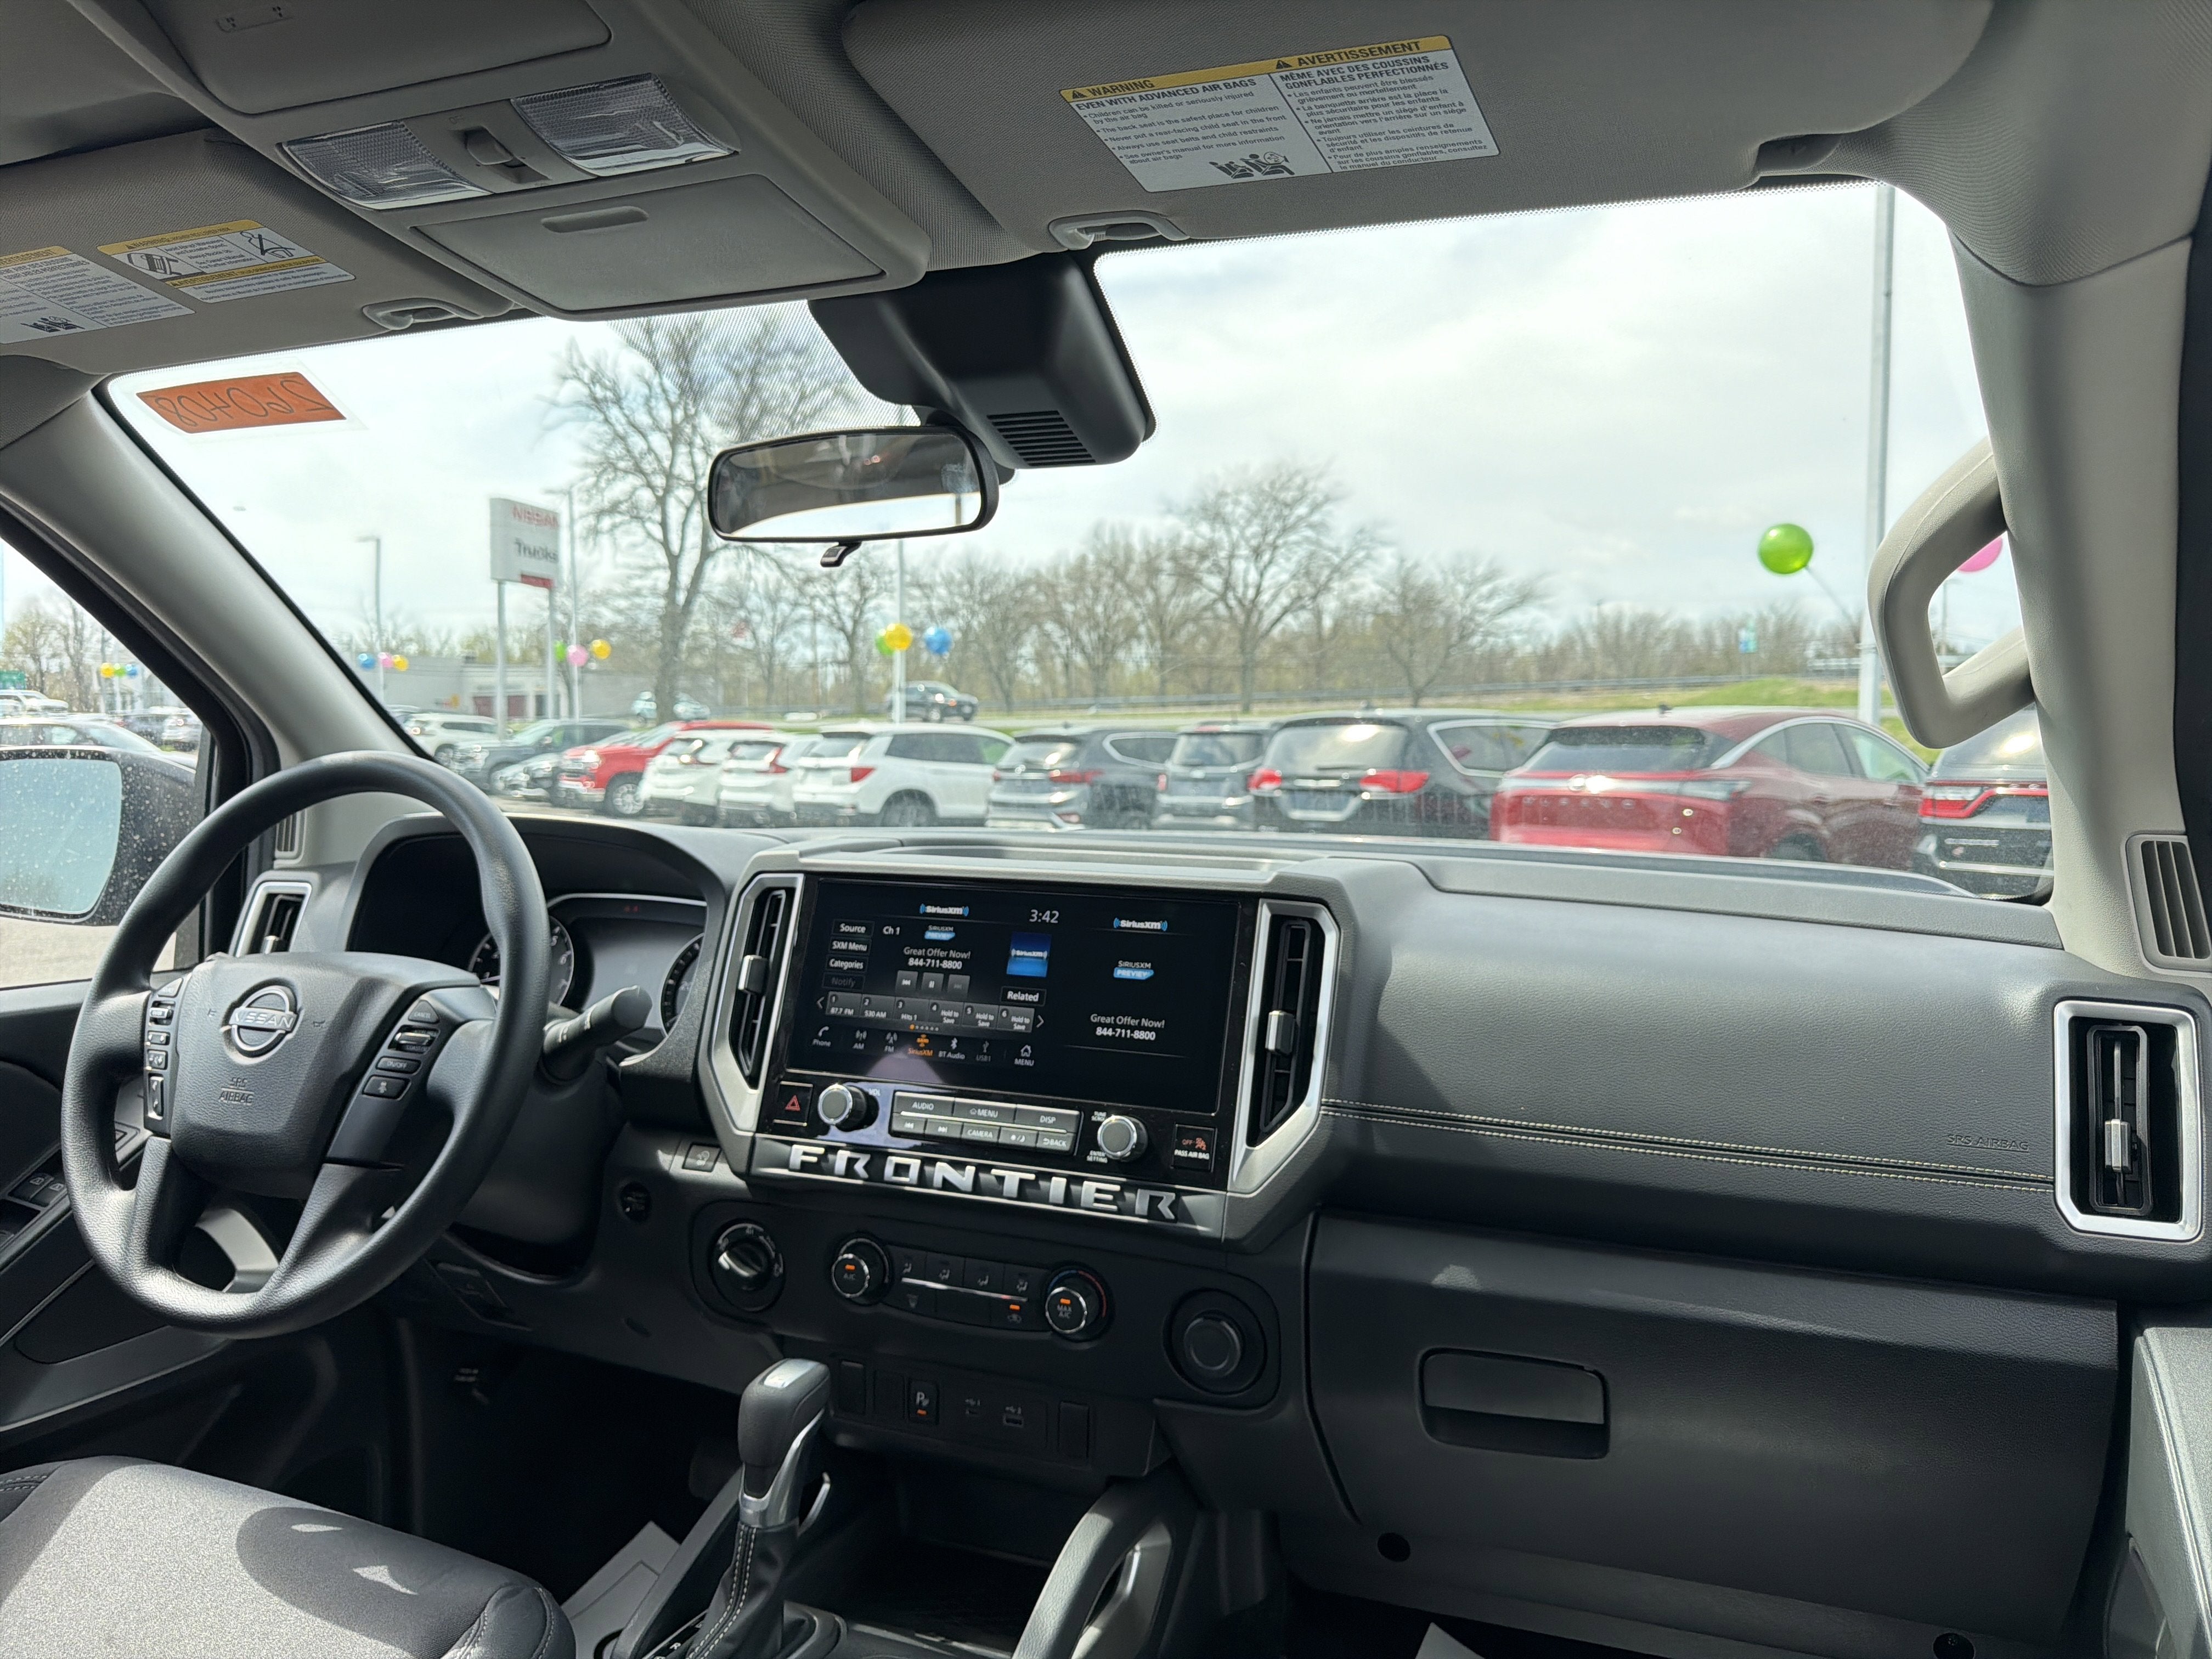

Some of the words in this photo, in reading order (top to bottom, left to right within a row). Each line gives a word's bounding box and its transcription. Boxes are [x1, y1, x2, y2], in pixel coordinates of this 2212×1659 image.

[1298, 41, 1419, 65] AVERTISSEMENT
[1279, 71, 1314, 81] MÊME
[1317, 67, 1345, 76] AVEC
[1346, 64, 1369, 72] DES
[1372, 56, 1429, 69] COUSSINS
[1285, 74, 1355, 89] GONFLABLES
[1357, 62, 1448, 79] PERFECTIONNÉS
[1087, 80, 1154, 95] WARNING
[1344, 82, 1379, 91] peuvent
[1399, 75, 1434, 84] blessés
[1075, 100, 1105, 110] EVEN
[1105, 96, 1137, 105] WITH
[1138, 87, 1199, 101] ADVANCED
[1201, 84, 1222, 92] AIR
[1223, 78, 1256, 89] BAGS
[1185, 96, 1222, 105] seriously
[1223, 91, 1254, 99] injured
[1297, 93, 1345, 104] grièvement
[1359, 84, 1417, 95] mortellement
[1155, 127, 1199, 136] rear-facing
[1239, 127, 1278, 135] restraints
[1238, 136, 1284, 145] information
[515, 537, 558, 563] Trucks
[1029, 909, 1059, 923] 3:42
[840, 923, 866, 933] Source
[883, 926, 894, 935] Ch
[896, 927, 900, 935] 1
[832, 941, 848, 950] SXM
[849, 942, 867, 951] Menu
[903, 946, 925, 956] Great
[927, 948, 947, 957] Offer
[949, 950, 971, 959] Now!
[830, 958, 864, 970] Categories
[908, 957, 962, 969] 844-711-8800
[1118, 960, 1151, 969] SIRIUSXM
[1116, 969, 1149, 978] PREVIEW
[831, 977, 856, 987] Notify
[1007, 991, 1040, 1002] Related
[830, 1007, 843, 1015] 87.7
[1091, 1014, 1115, 1024] Great
[1117, 1015, 1139, 1026] Offer
[1142, 1017, 1165, 1028] Now!
[1013, 1023, 1026, 1031] Save
[1096, 1026, 1156, 1040] 844-711-8800
[812, 1039, 831, 1047] Phone
[907, 1048, 933, 1057] SiriusXM
[947, 1051, 966, 1060] Audio
[975, 1054, 991, 1062] USB1
[1014, 1058, 1035, 1066] MENU
[229, 1077, 247, 1088] SRS
[221, 1091, 254, 1105] AIRBAG
[869, 1088, 881, 1097] VOL
[912, 1101, 934, 1110] AUDIO
[977, 1108, 998, 1119] MENU
[1040, 1115, 1057, 1124] DISP
[967, 1128, 993, 1139] CAMERA
[1049, 1137, 1066, 1147] BACK
[1948, 1133, 1972, 1145] SRS
[1976, 1136, 2029, 1150] AIRBAG
[1198, 1152, 1210, 1160] BAG
[789, 1144, 1177, 1219] FRONTIER
